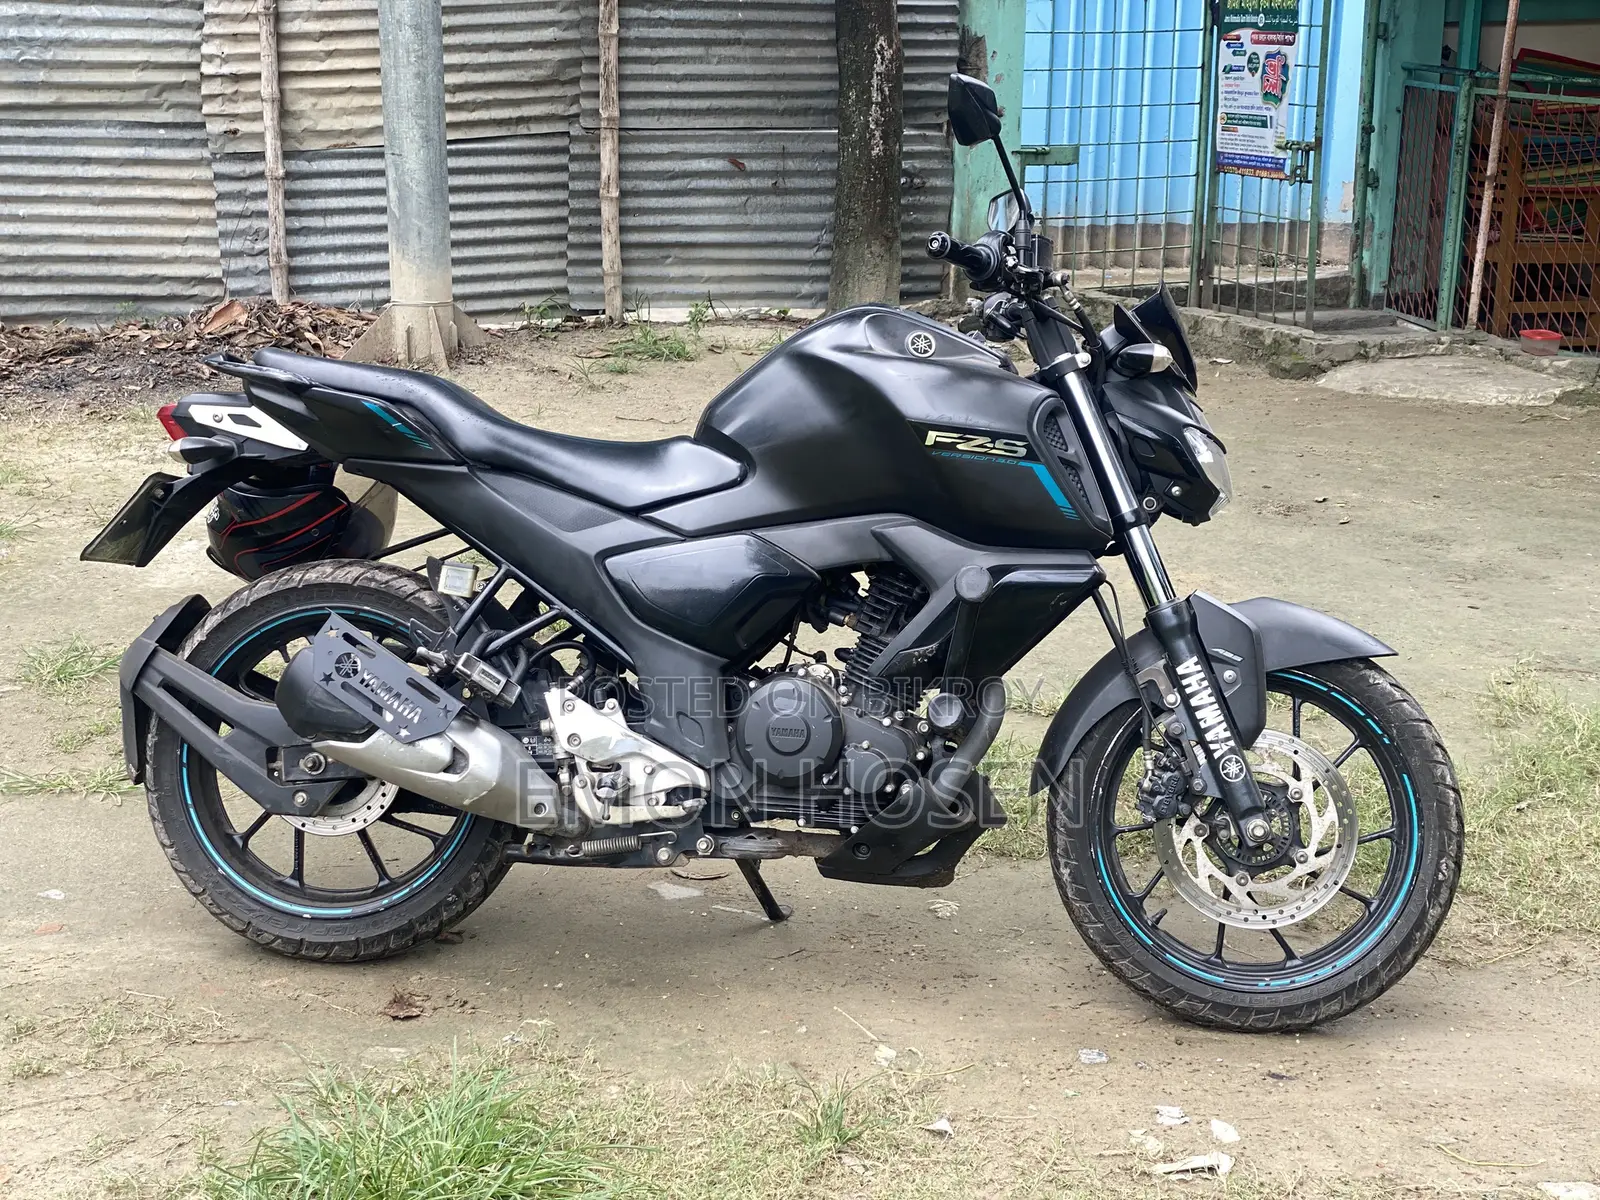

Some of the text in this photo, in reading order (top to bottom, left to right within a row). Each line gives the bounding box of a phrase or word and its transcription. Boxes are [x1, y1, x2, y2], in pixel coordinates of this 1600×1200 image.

[359, 669, 423, 724] YAMAHA
[1176, 655, 1235, 760] YAMAHA
[771, 727, 806, 739] YAMAHA
